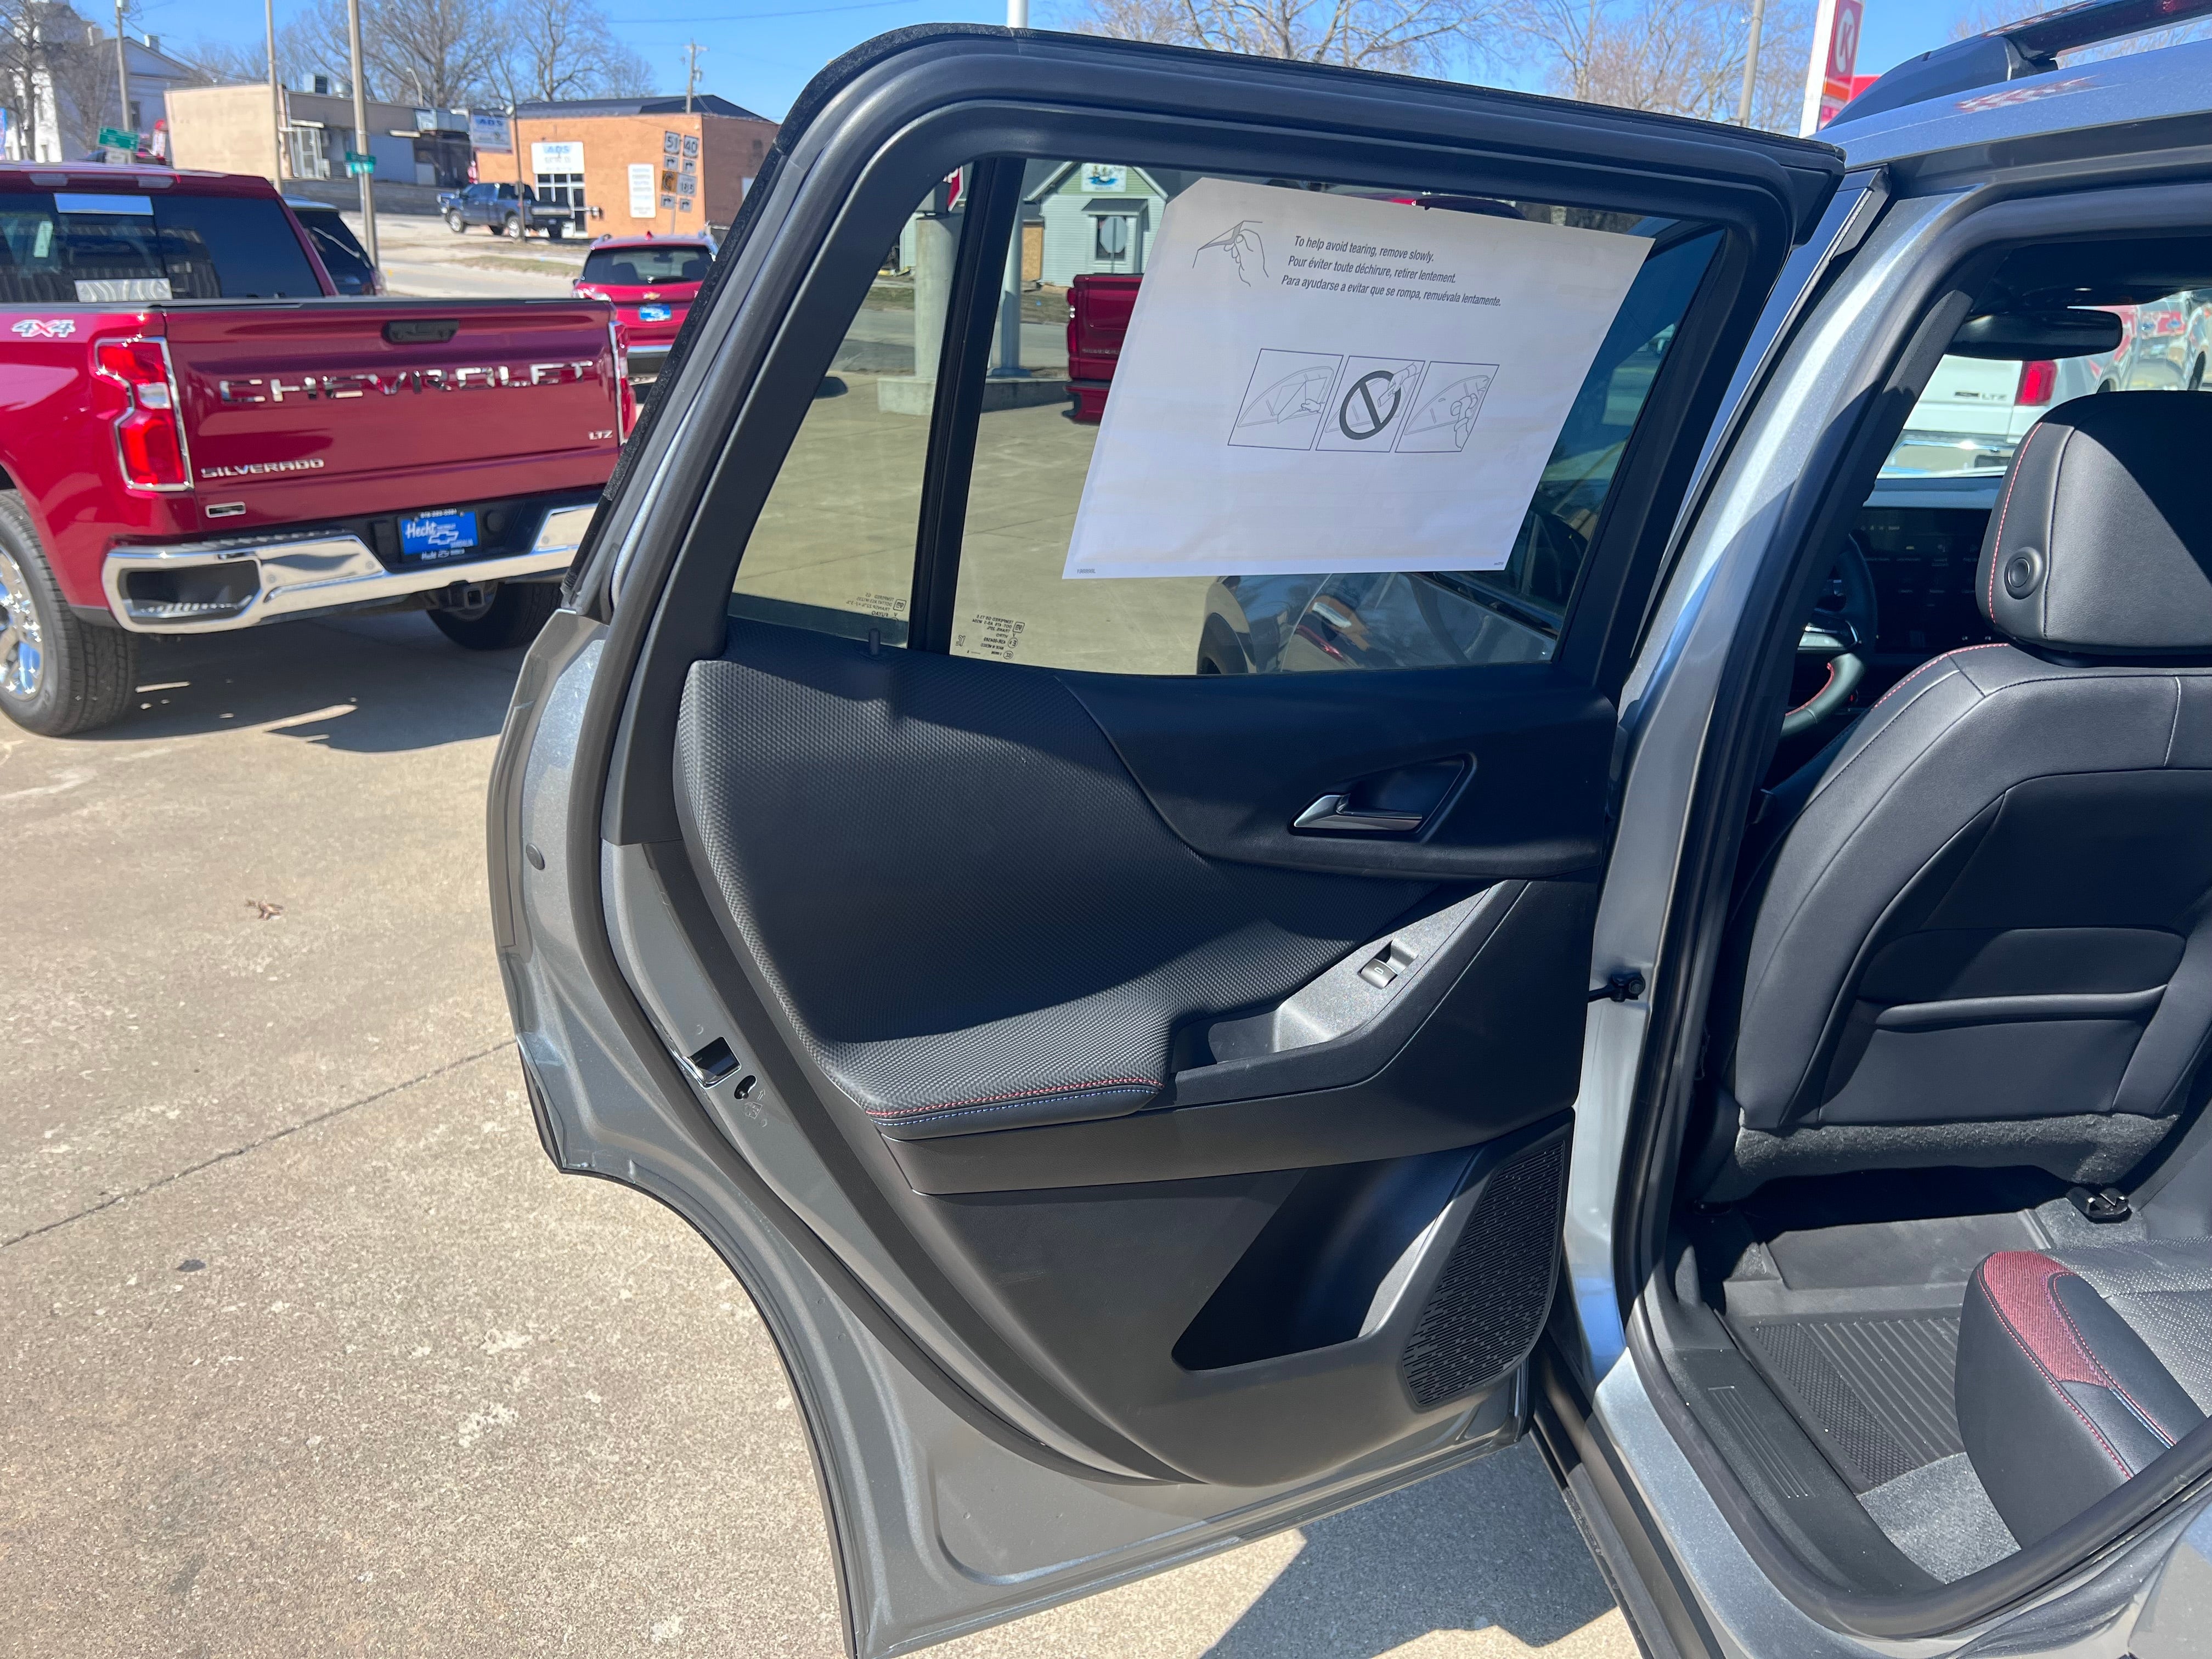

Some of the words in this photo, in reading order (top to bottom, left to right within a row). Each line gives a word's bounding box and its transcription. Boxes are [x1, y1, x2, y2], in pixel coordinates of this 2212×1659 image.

[547, 145, 570, 154] ADS
[667, 136, 679, 149] 51
[685, 140, 698, 153] 40
[1295, 235, 1305, 247] To
[1306, 237, 1324, 251] help
[1325, 241, 1348, 252] avoid
[1349, 242, 1377, 257] tearing,
[1379, 247, 1408, 259] remove
[1409, 250, 1434, 264] slowly.
[1288, 255, 1307, 267] Pour
[1308, 257, 1333, 270] éviter
[1334, 261, 1354, 273] toute
[1355, 262, 1392, 279] déchirure,
[1394, 268, 1419, 280] retirer
[1418, 269, 1456, 284] lentement.
[1282, 275, 1300, 286] Para
[1301, 279, 1339, 291] ayudarse
[1340, 284, 1346, 292] a
[1347, 283, 1370, 294] evitar
[1370, 286, 1385, 297] que
[1386, 288, 1396, 297] se
[1396, 289, 1421, 300] rompa,
[1423, 291, 1461, 302] remuévala
[1462, 294, 1501, 307] lentamente.
[219, 360, 593, 403] CHEVROLET
[588, 430, 613, 441] LTZ
[201, 458, 325, 479] SILVERADO
[405, 520, 437, 539] Hecht
